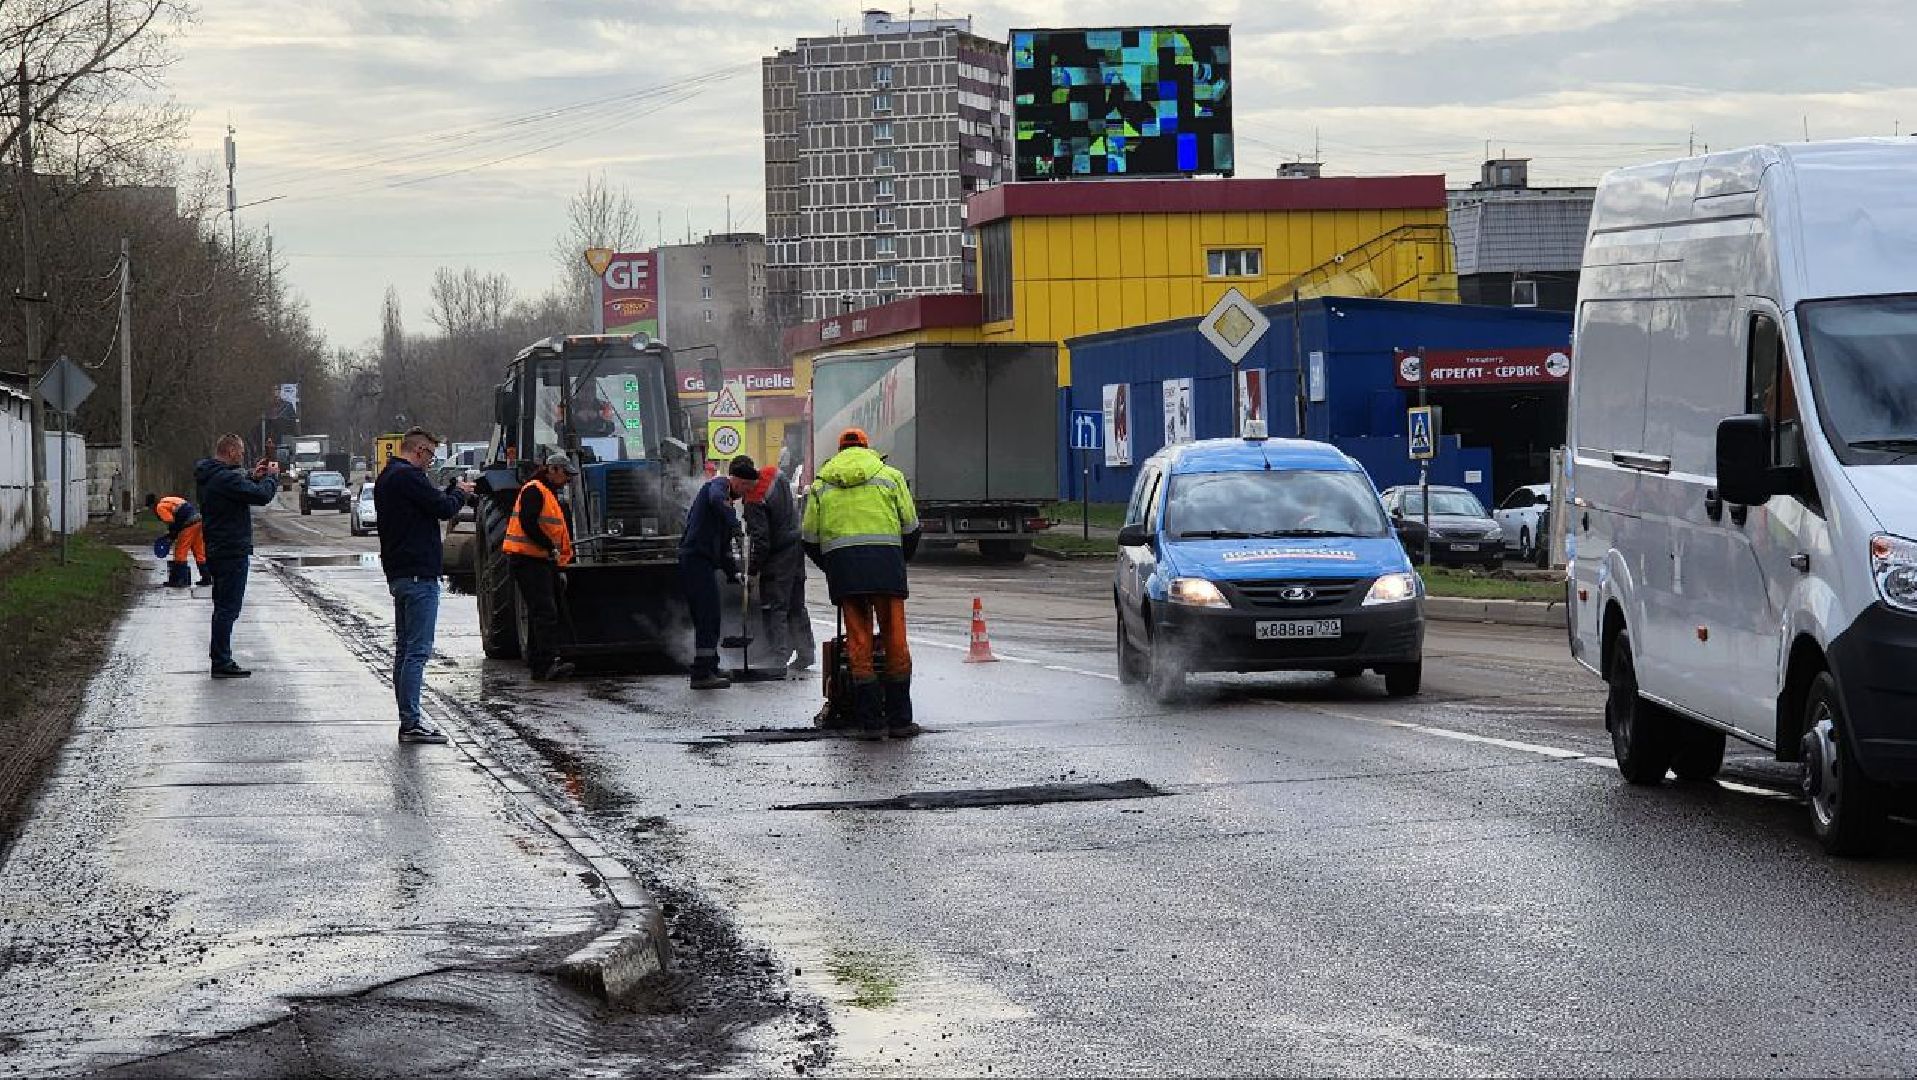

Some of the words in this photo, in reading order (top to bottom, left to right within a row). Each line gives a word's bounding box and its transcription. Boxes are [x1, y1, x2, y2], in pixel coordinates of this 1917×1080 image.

[606, 261, 649, 290] GF
[1431, 367, 1483, 380] АГРЕГАТ
[1495, 365, 1542, 378] СЕРВИС
[719, 434, 736, 447] 40
